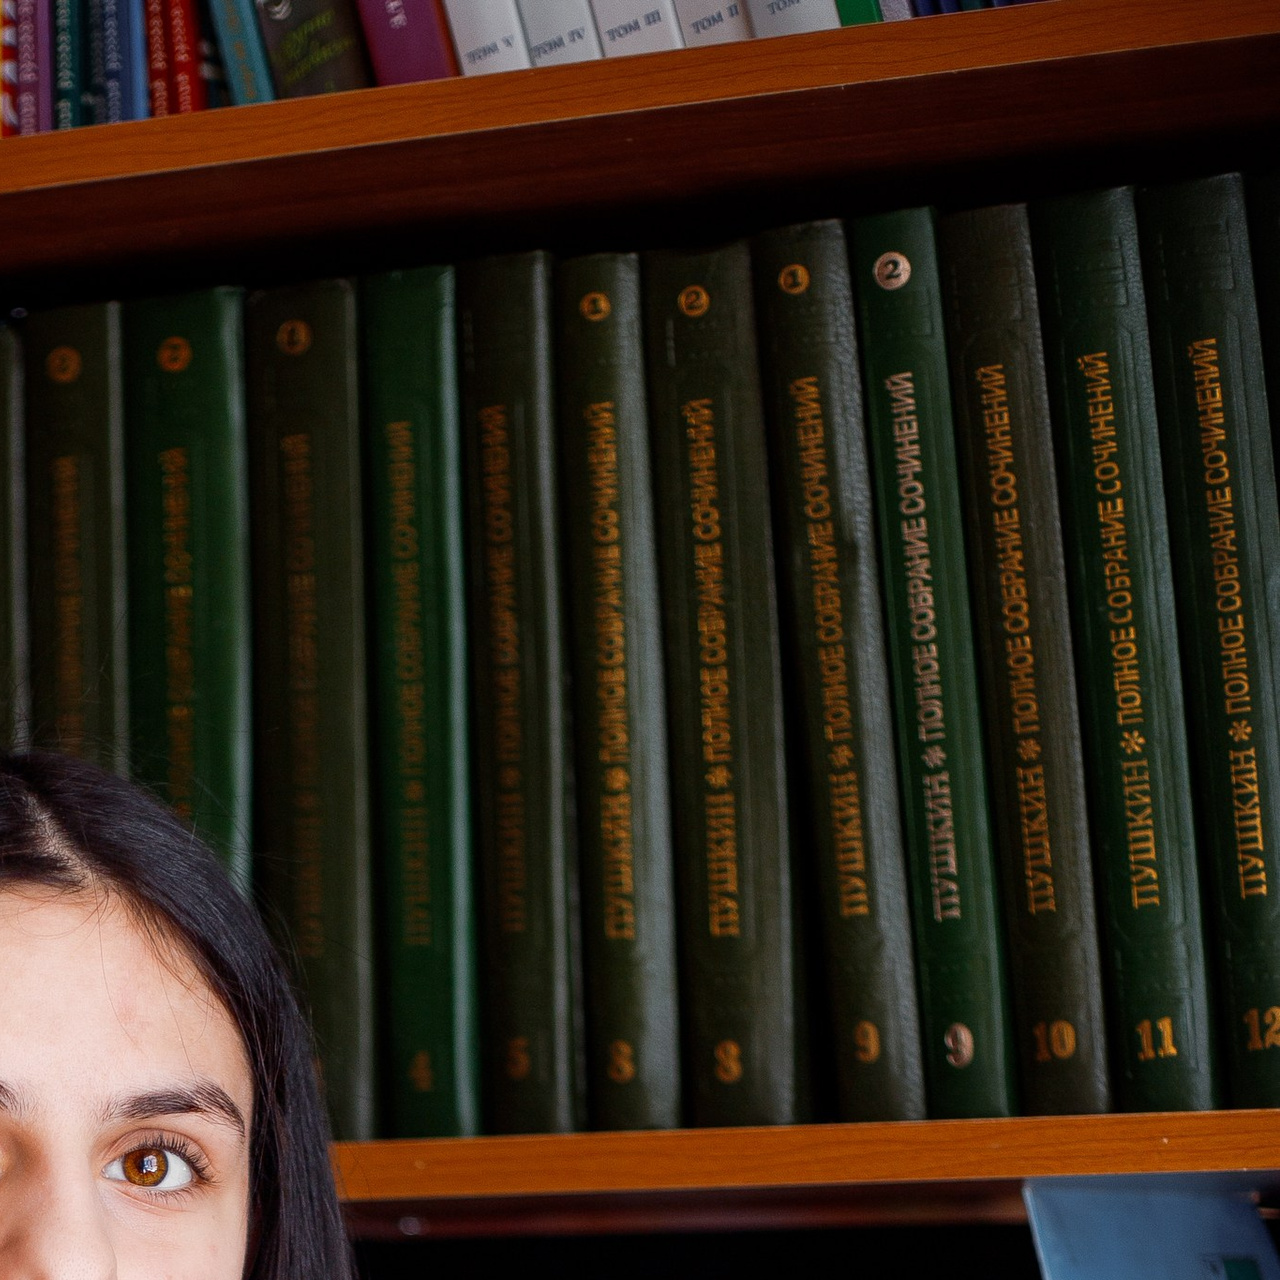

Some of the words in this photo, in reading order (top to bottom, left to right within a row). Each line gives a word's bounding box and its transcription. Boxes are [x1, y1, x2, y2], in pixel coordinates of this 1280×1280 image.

[606, 20, 641, 42] ТОМ
[645, 9, 663, 26] III
[692, 12, 724, 34] ТОМ
[728, 3, 741, 17] II
[479, 404, 515, 542] СОЧИНЕНИЙ
[585, 401, 621, 542] СОЧИНЕНИЙ
[684, 398, 721, 541] СОЧИНЕНИЙ
[789, 375, 832, 519] СОЧИНЕНИЙ
[884, 371, 925, 515] СОЧИНЕНИЙ
[975, 363, 1018, 506] СОЧИНЕНИЙ
[1079, 351, 1122, 495] СОЧИНЕНИЙ
[1187, 337, 1230, 486] СОЧИНЕНИЙ
[384, 420, 419, 558] СОЧИНЕНИЙ
[1202, 487, 1242, 613] СОБРАНИЕ
[391, 562, 424, 680] СОБРАНИЕ
[591, 542, 625, 666] СОБРАНИЕ
[692, 542, 727, 664] СОБРАНИЕ
[804, 521, 844, 643] СОБРАНИЕ
[898, 516, 937, 642] СОБРАНИЕ
[991, 508, 1030, 634] СОБРАНИЕ
[1095, 497, 1135, 625] СОБРАНИЕ
[596, 666, 629, 763] ПОЛНОЕ
[697, 665, 731, 762] ПОЛНОЕ
[816, 643, 853, 742] ПОЛНОЕ
[910, 642, 946, 742] ПОЛНОЕ
[1003, 634, 1039, 734] ПОЛНОЕ
[1107, 626, 1144, 726] ПОЛНОЕ
[1214, 614, 1252, 715] ПОЛНОЕ
[600, 793, 635, 940] ПУШКИН
[703, 792, 739, 938] ПУШКИН
[828, 770, 869, 918] ПУШКИН
[921, 770, 962, 922] ПУШКИН
[1015, 764, 1057, 915] ПУШКИН
[1119, 758, 1161, 909] ПУШКИН
[1227, 746, 1269, 898] ПУШКИН
[608, 1041, 634, 1082] 8
[715, 1040, 742, 1083] 8
[854, 1021, 881, 1063] 9
[943, 1022, 974, 1068] 9
[1034, 1018, 1076, 1059] 10
[1136, 1016, 1177, 1060] 11
[1245, 1005, 1280, 1051] 12
